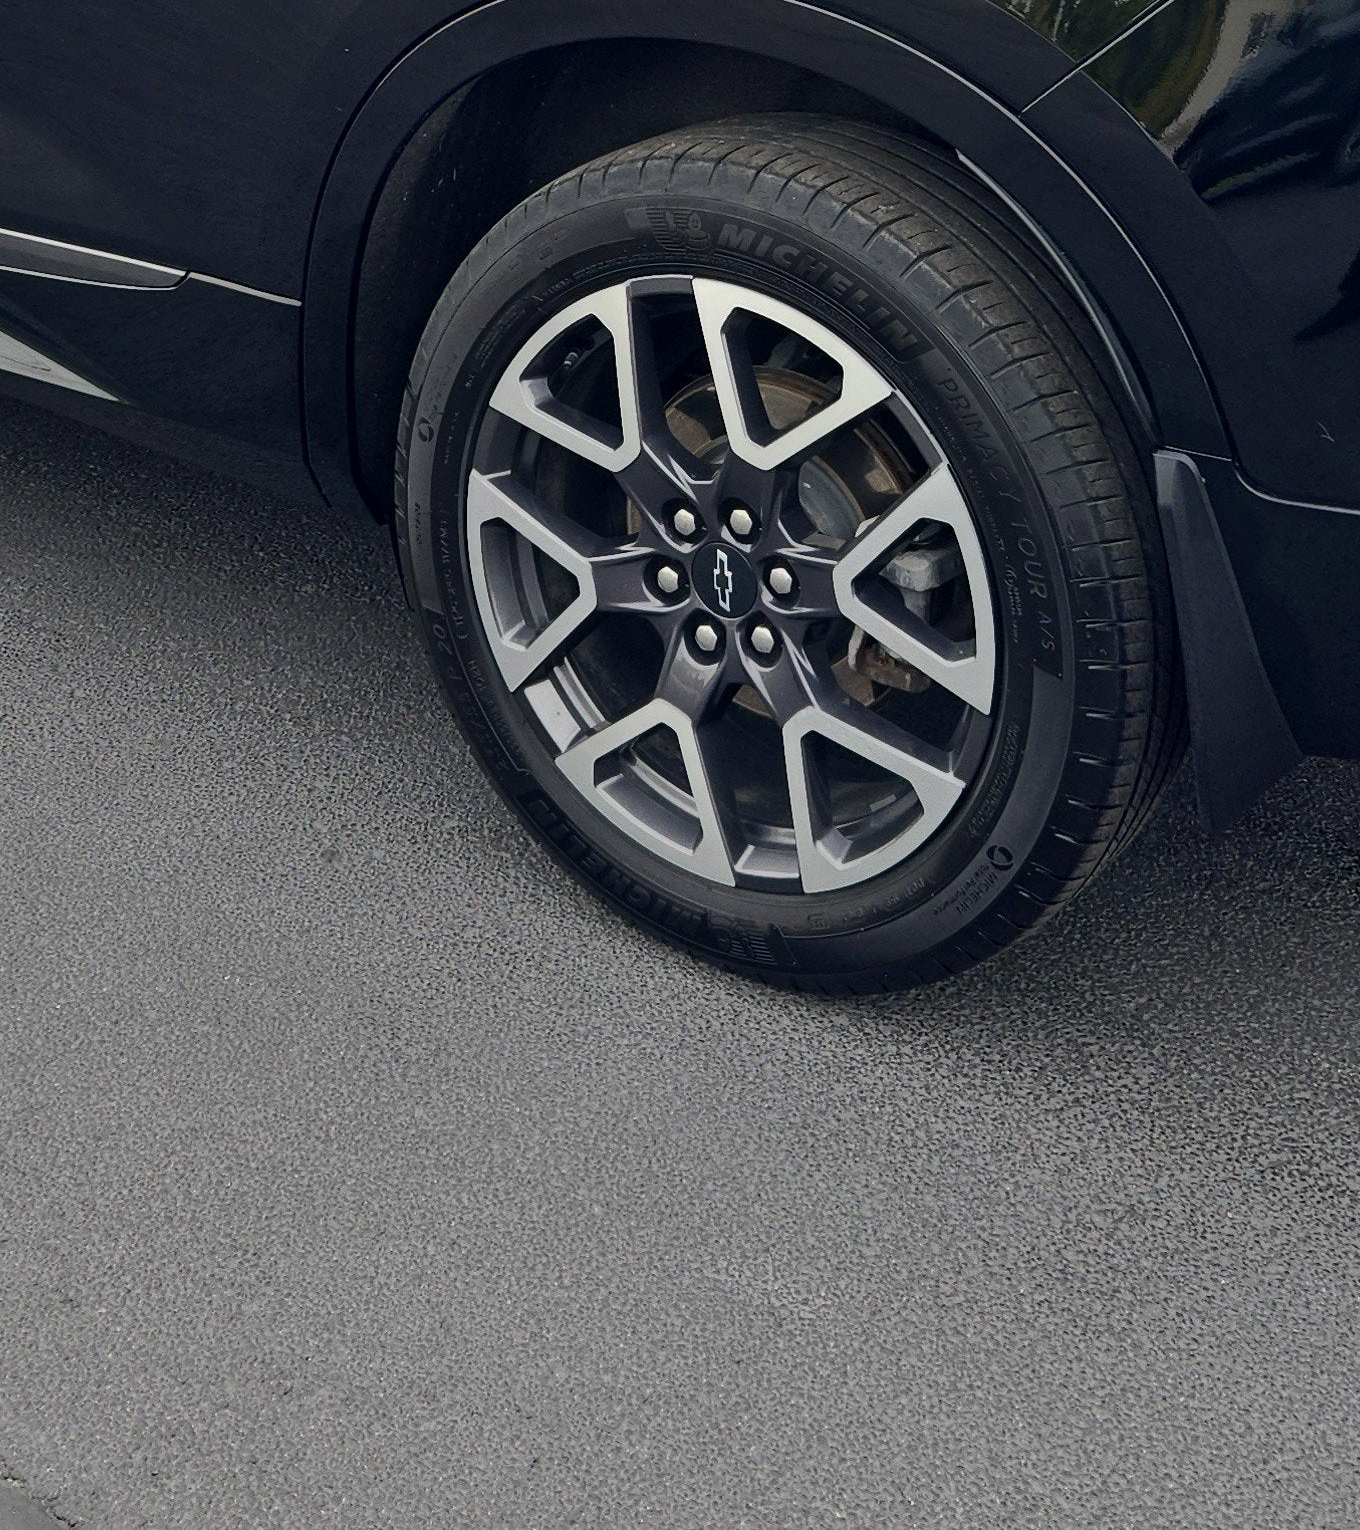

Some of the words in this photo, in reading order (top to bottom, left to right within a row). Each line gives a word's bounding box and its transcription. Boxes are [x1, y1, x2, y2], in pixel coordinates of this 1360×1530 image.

[717, 223, 920, 358] MICHELIN
[934, 376, 1023, 507] PRIMACY
[1010, 516, 1049, 598] TOUR
[1038, 612, 1056, 653] A/S
